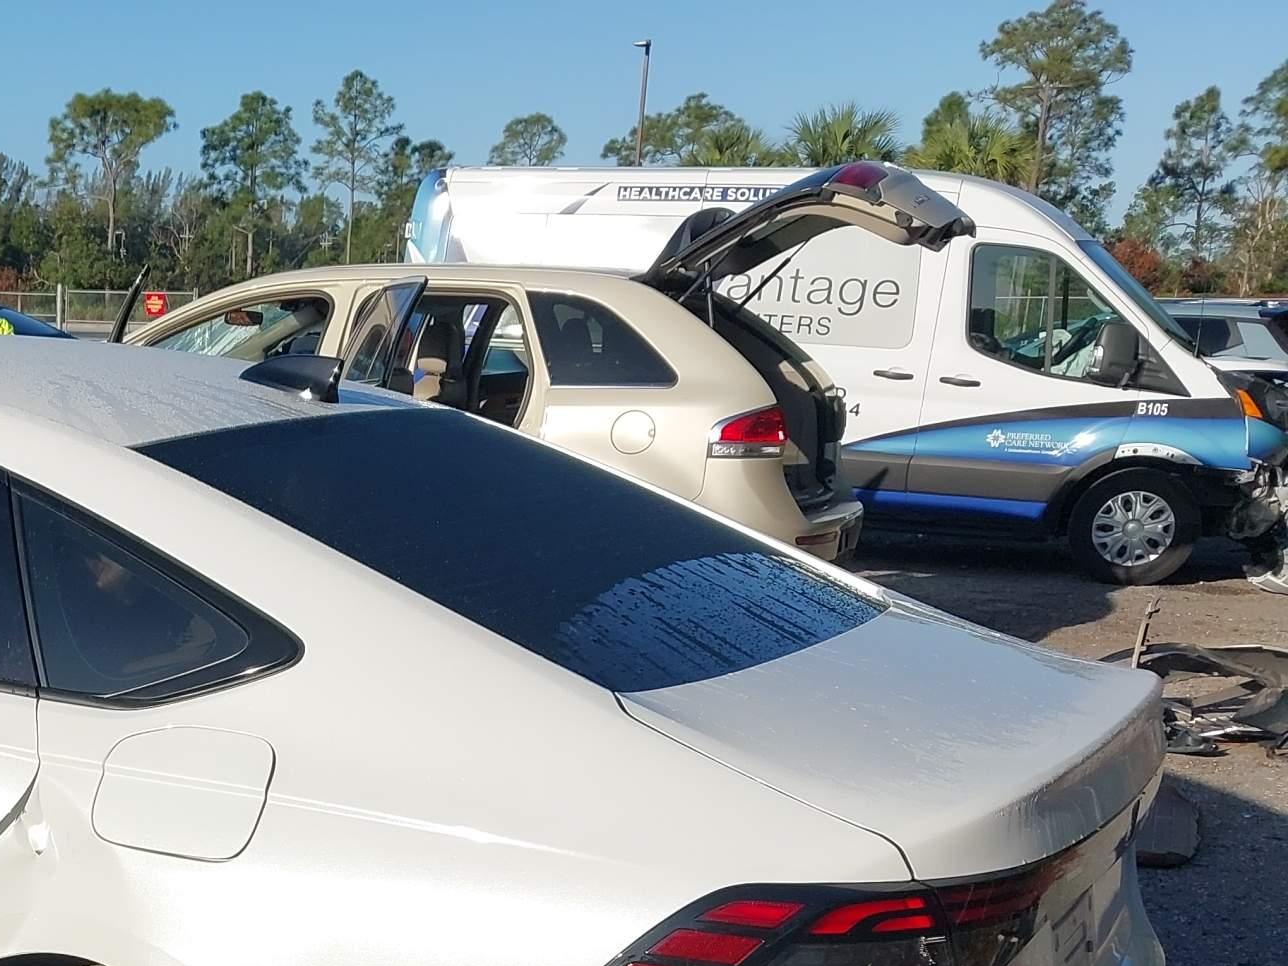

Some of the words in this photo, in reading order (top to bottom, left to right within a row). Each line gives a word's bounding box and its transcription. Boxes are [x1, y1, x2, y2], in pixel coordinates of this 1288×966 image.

[618, 186, 723, 201] HEALTHCARE
[756, 313, 832, 336] TERS
[1137, 402, 1169, 416] B105
[1006, 431, 1052, 441] PREFERRED
[1004, 439, 1028, 448] CARE
[1028, 440, 1070, 450] NETWORK
